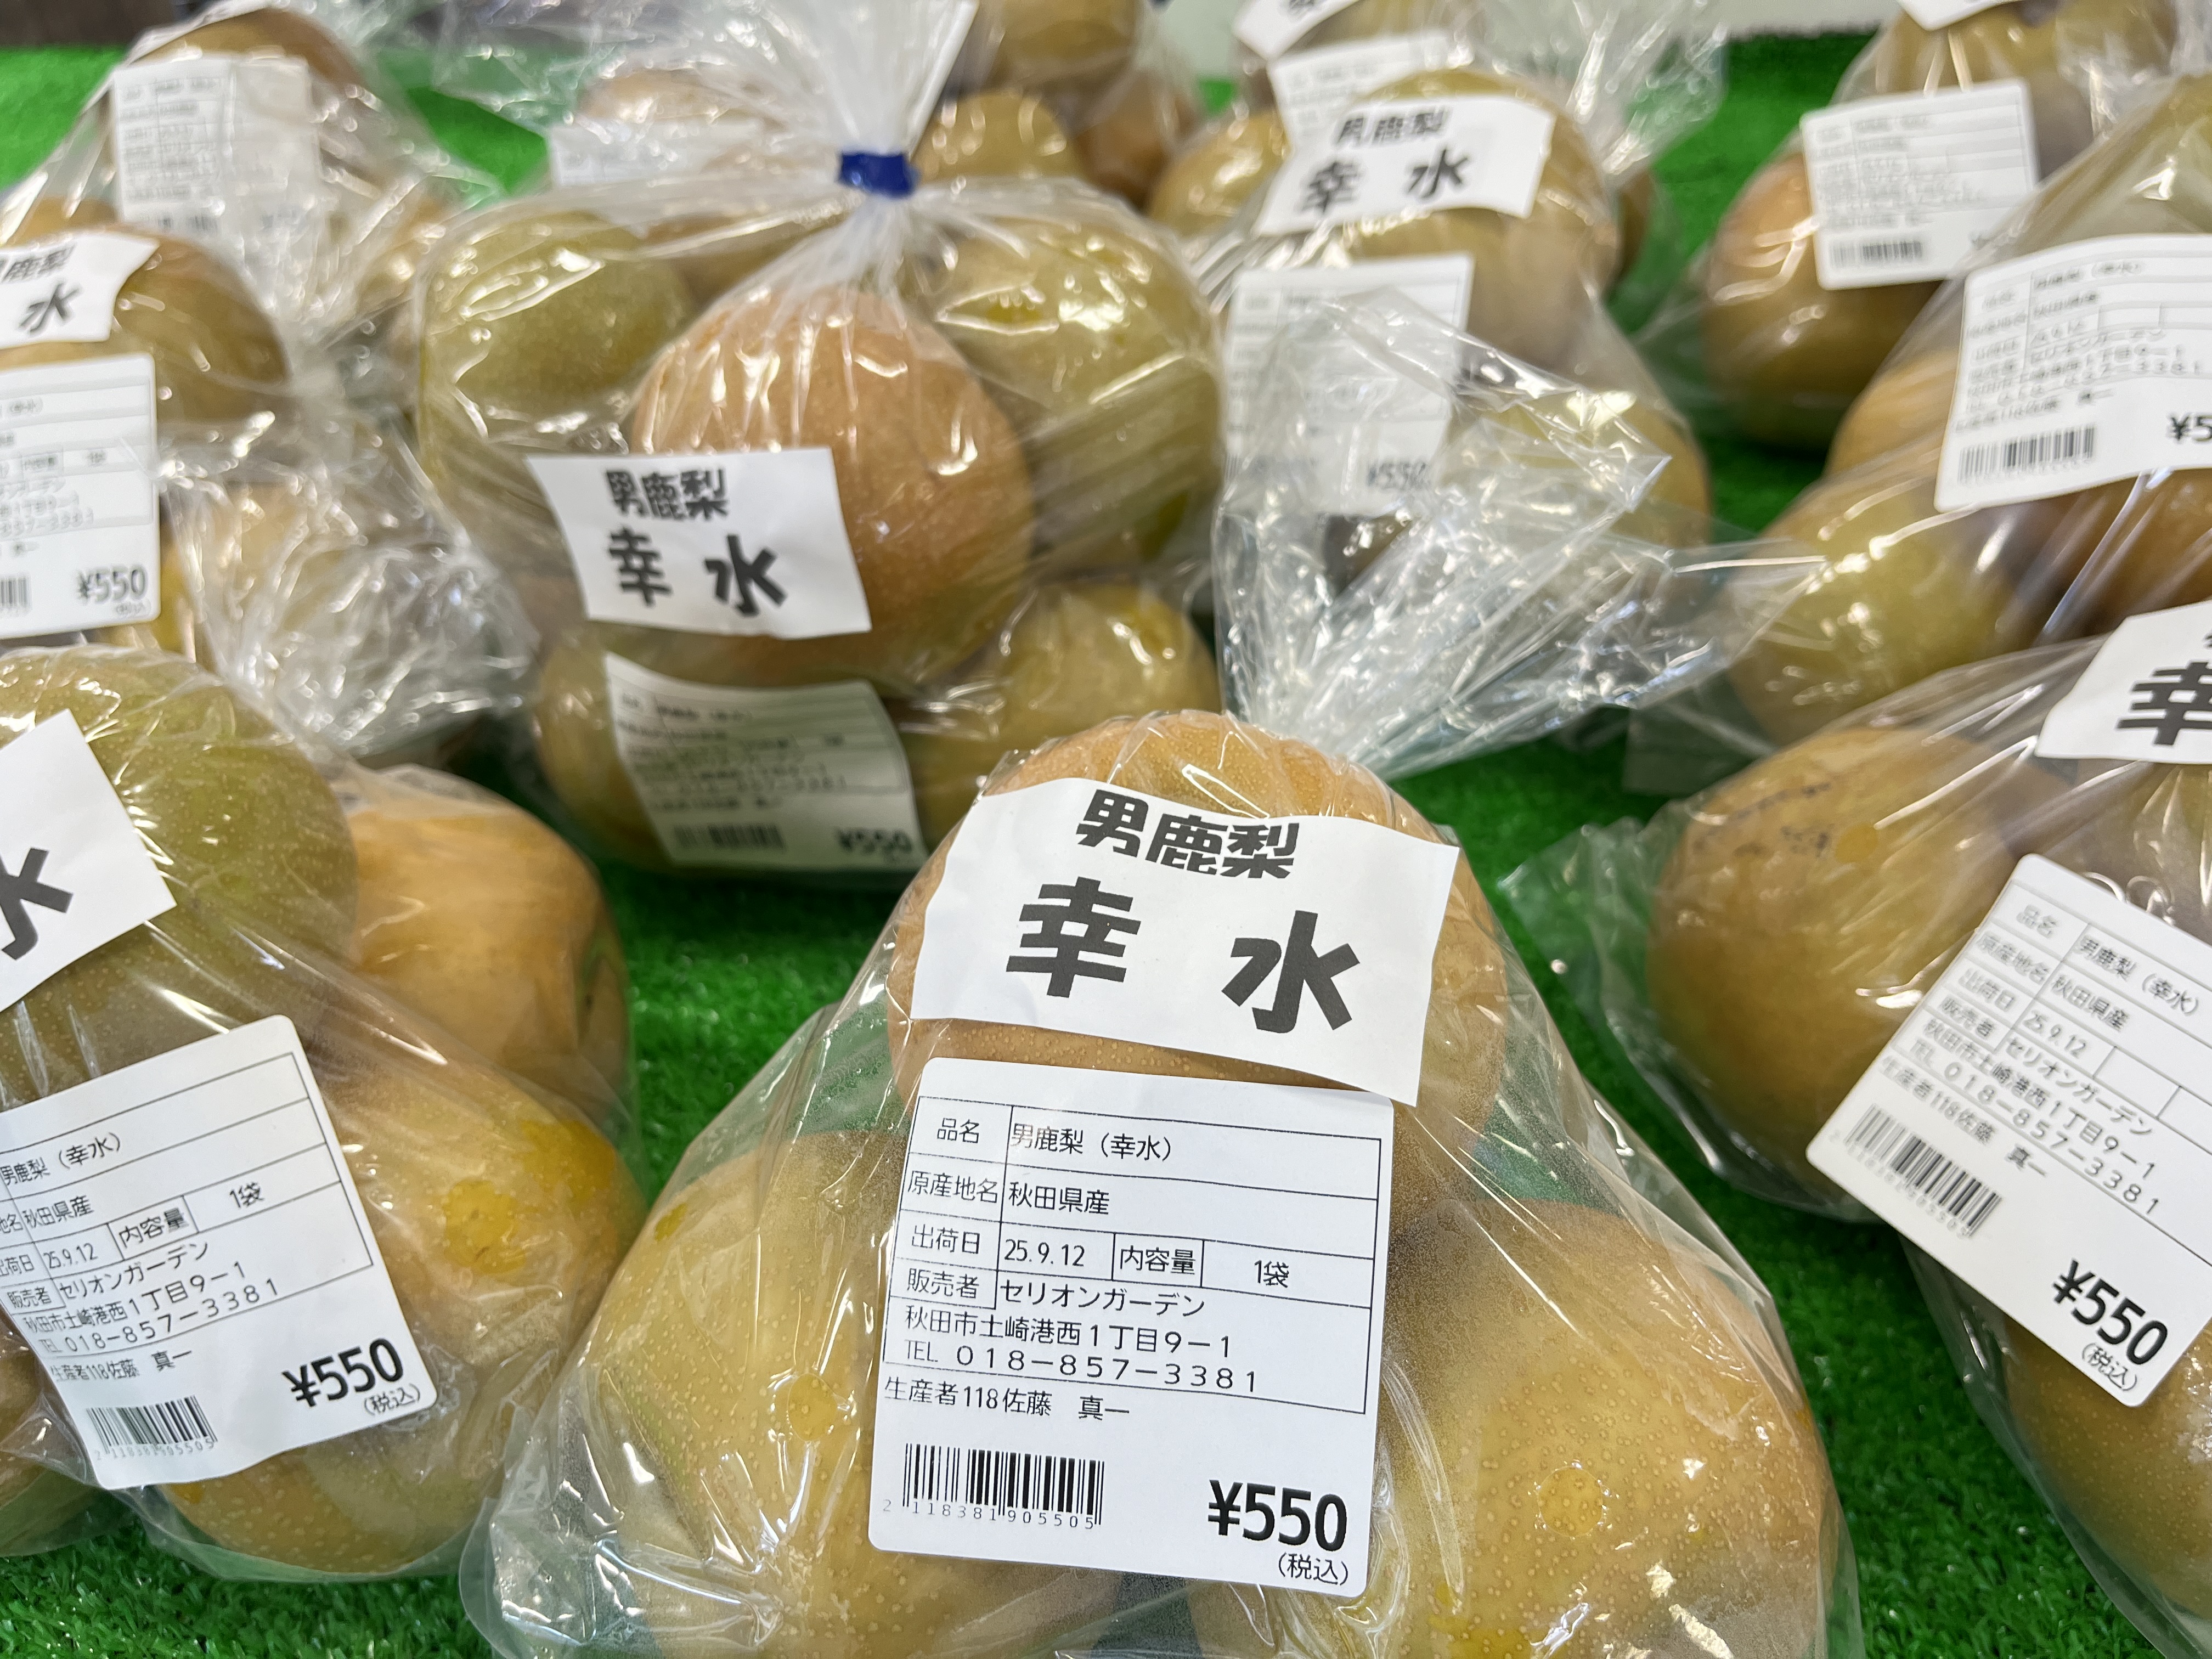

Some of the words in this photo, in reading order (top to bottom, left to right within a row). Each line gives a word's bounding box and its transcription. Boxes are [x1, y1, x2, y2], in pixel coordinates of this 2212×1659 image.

[607, 469, 727, 520] 男鹿梨
[78, 564, 146, 602] ¥550
[610, 527, 672, 606] 幸
[705, 534, 786, 616] 水
[2115, 662, 2212, 746] 幸
[1076, 789, 1299, 879] 男鹿梨
[1006, 877, 1141, 997] 幸
[1221, 910, 1360, 1033] 水
[2051, 975, 2131, 1031] 秋田県産
[2006, 1037, 2153, 1135] セリオンガーデン
[936, 1117, 980, 1144] 品名
[2006, 1144, 2047, 1177] 真一
[25, 1194, 94, 1229] 秋田県産
[908, 1170, 997, 1204] 原産地名
[1008, 1181, 1109, 1215] 秋田県産
[43, 1242, 98, 1270] 25.9.12
[119, 1206, 189, 1249] 内容量
[229, 1182, 266, 1209] 1袋
[7, 1286, 52, 1310] 販売者
[60, 1242, 209, 1300] セリオンガーデン
[911, 1224, 980, 1254] 出荷日
[1004, 1239, 1085, 1267] 25.9.12
[1120, 1245, 1196, 1275] 内容量
[1254, 1260, 1290, 1288] 1袋
[907, 1268, 979, 1299] 販売者
[1000, 1279, 1205, 1317] セリオンガーデン
[2052, 1259, 2168, 1365] ¥550
[151, 1350, 193, 1372] 真一
[282, 1339, 404, 1407] ¥550
[905, 1339, 938, 1363] TEL
[2081, 1342, 2137, 1392] (税込)
[364, 1383, 421, 1416] (税込)
[884, 1376, 1053, 1417] 生産者118佐藤
[1078, 1395, 1130, 1421] 真一
[1208, 1480, 1347, 1551] ¥550
[1278, 1552, 1348, 1586] (税込)
